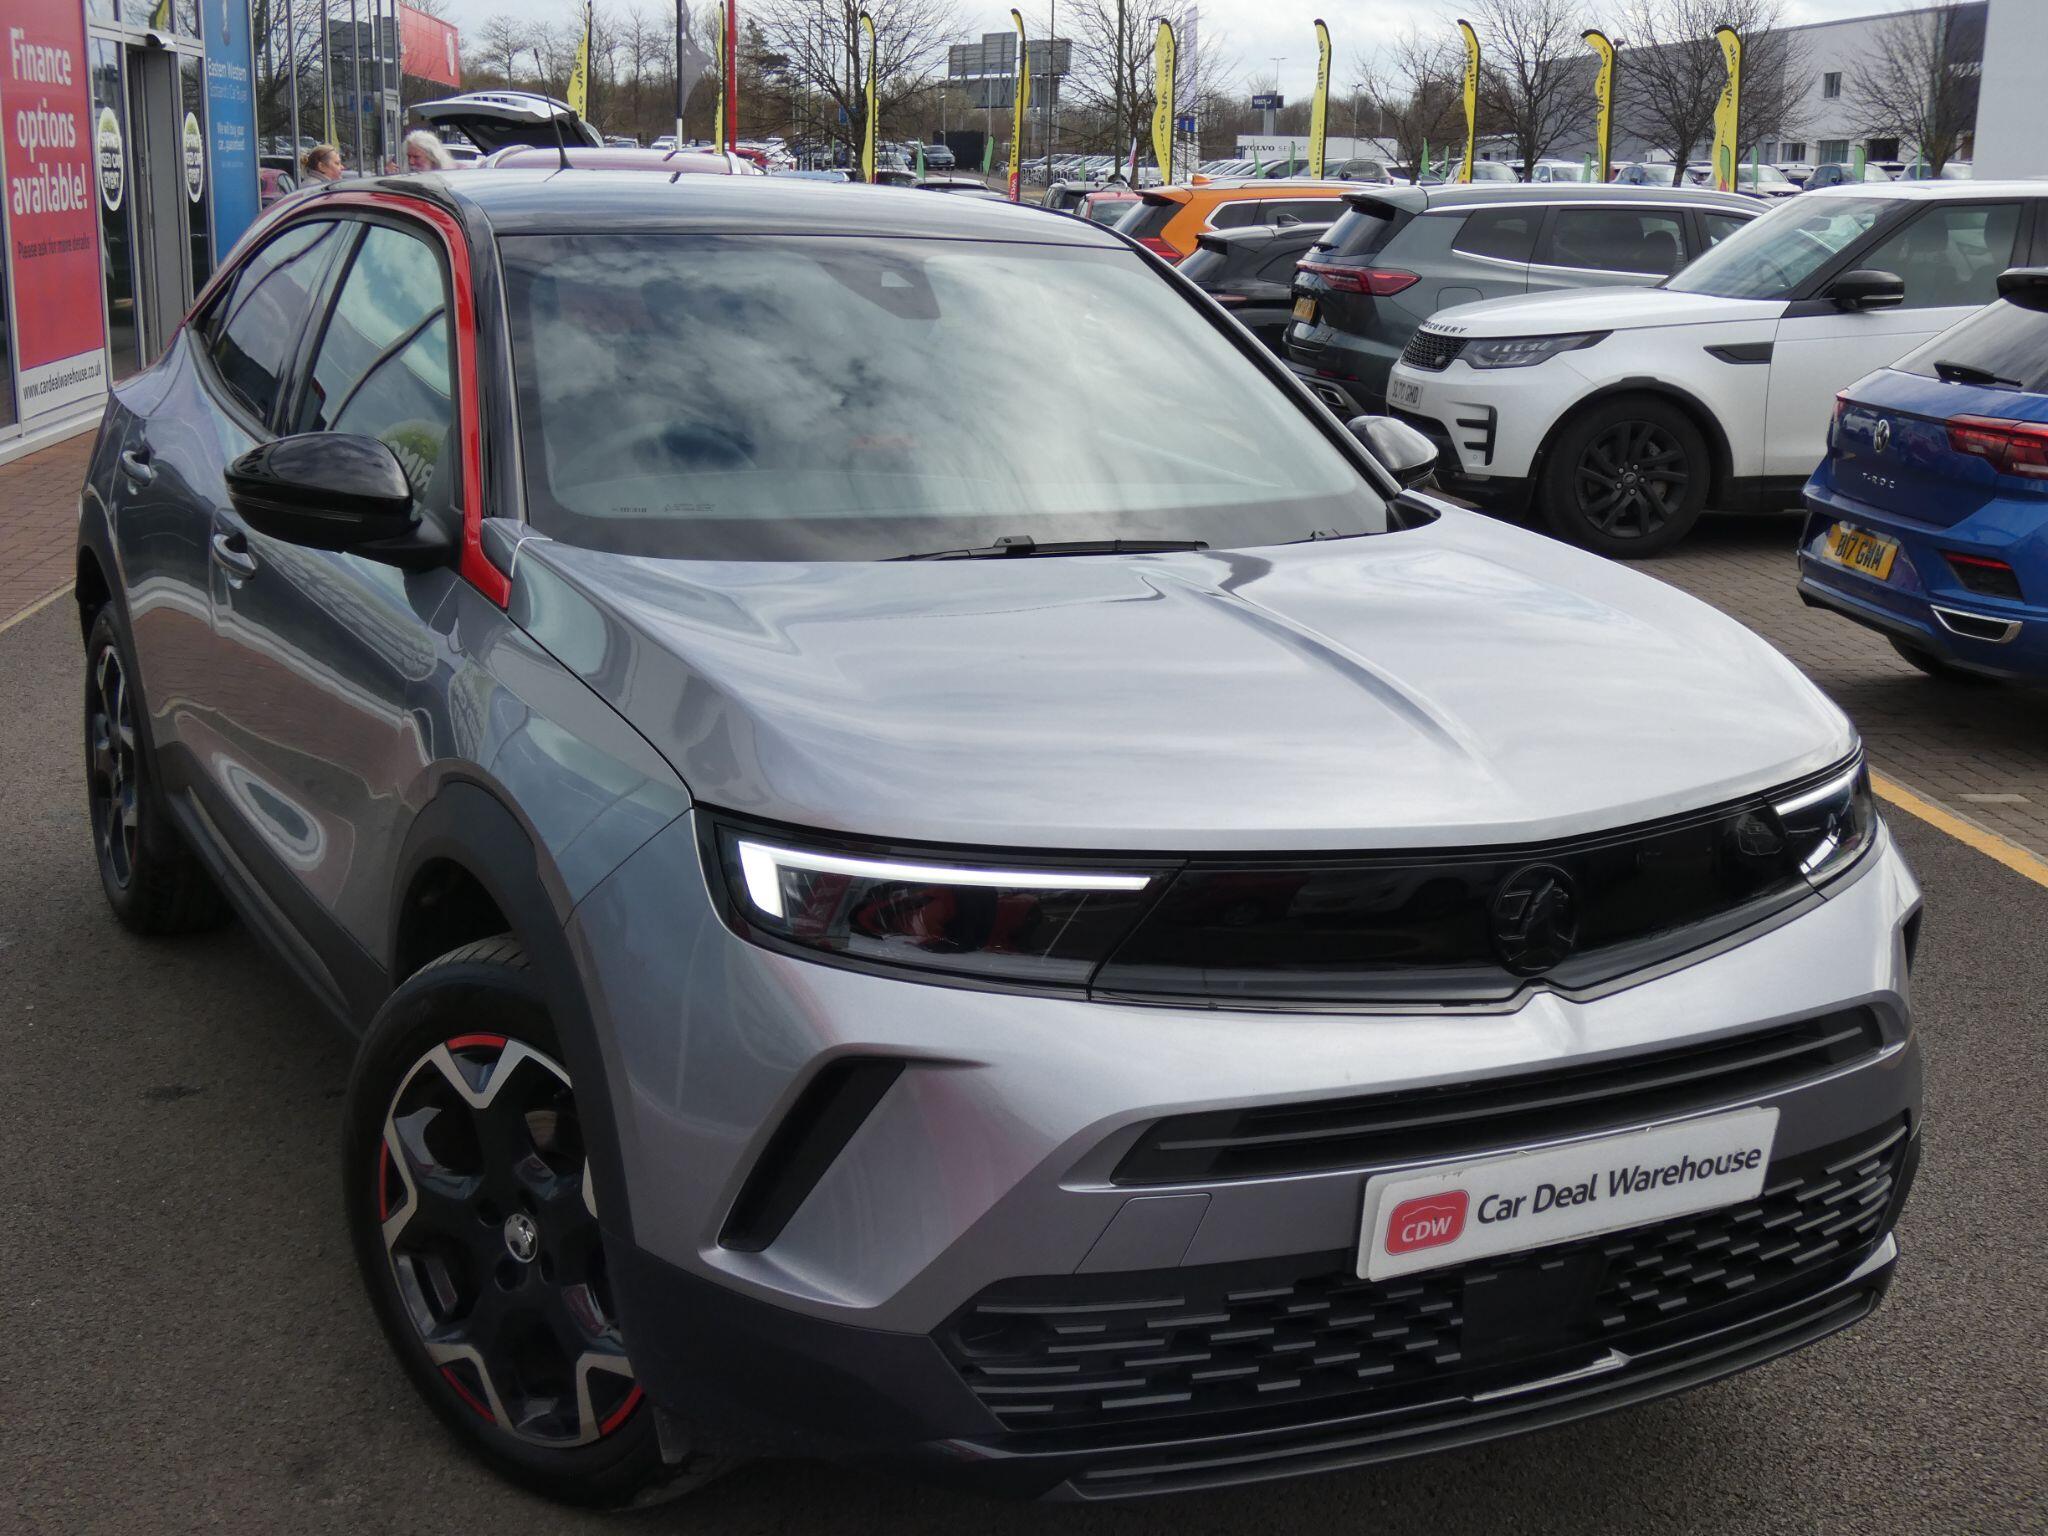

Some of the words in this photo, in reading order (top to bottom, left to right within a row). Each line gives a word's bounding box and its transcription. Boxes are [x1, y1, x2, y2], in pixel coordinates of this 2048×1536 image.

[9, 27, 72, 86] Finance
[16, 98, 77, 163] options
[12, 163, 87, 215] available!
[22, 359, 102, 400] www.cardealwarehouse.co.uk
[1477, 1194, 1528, 1224] Car
[1532, 1175, 1598, 1213] Deal
[1608, 1148, 1762, 1198] Warehouse
[1401, 1215, 1453, 1244] CDW
